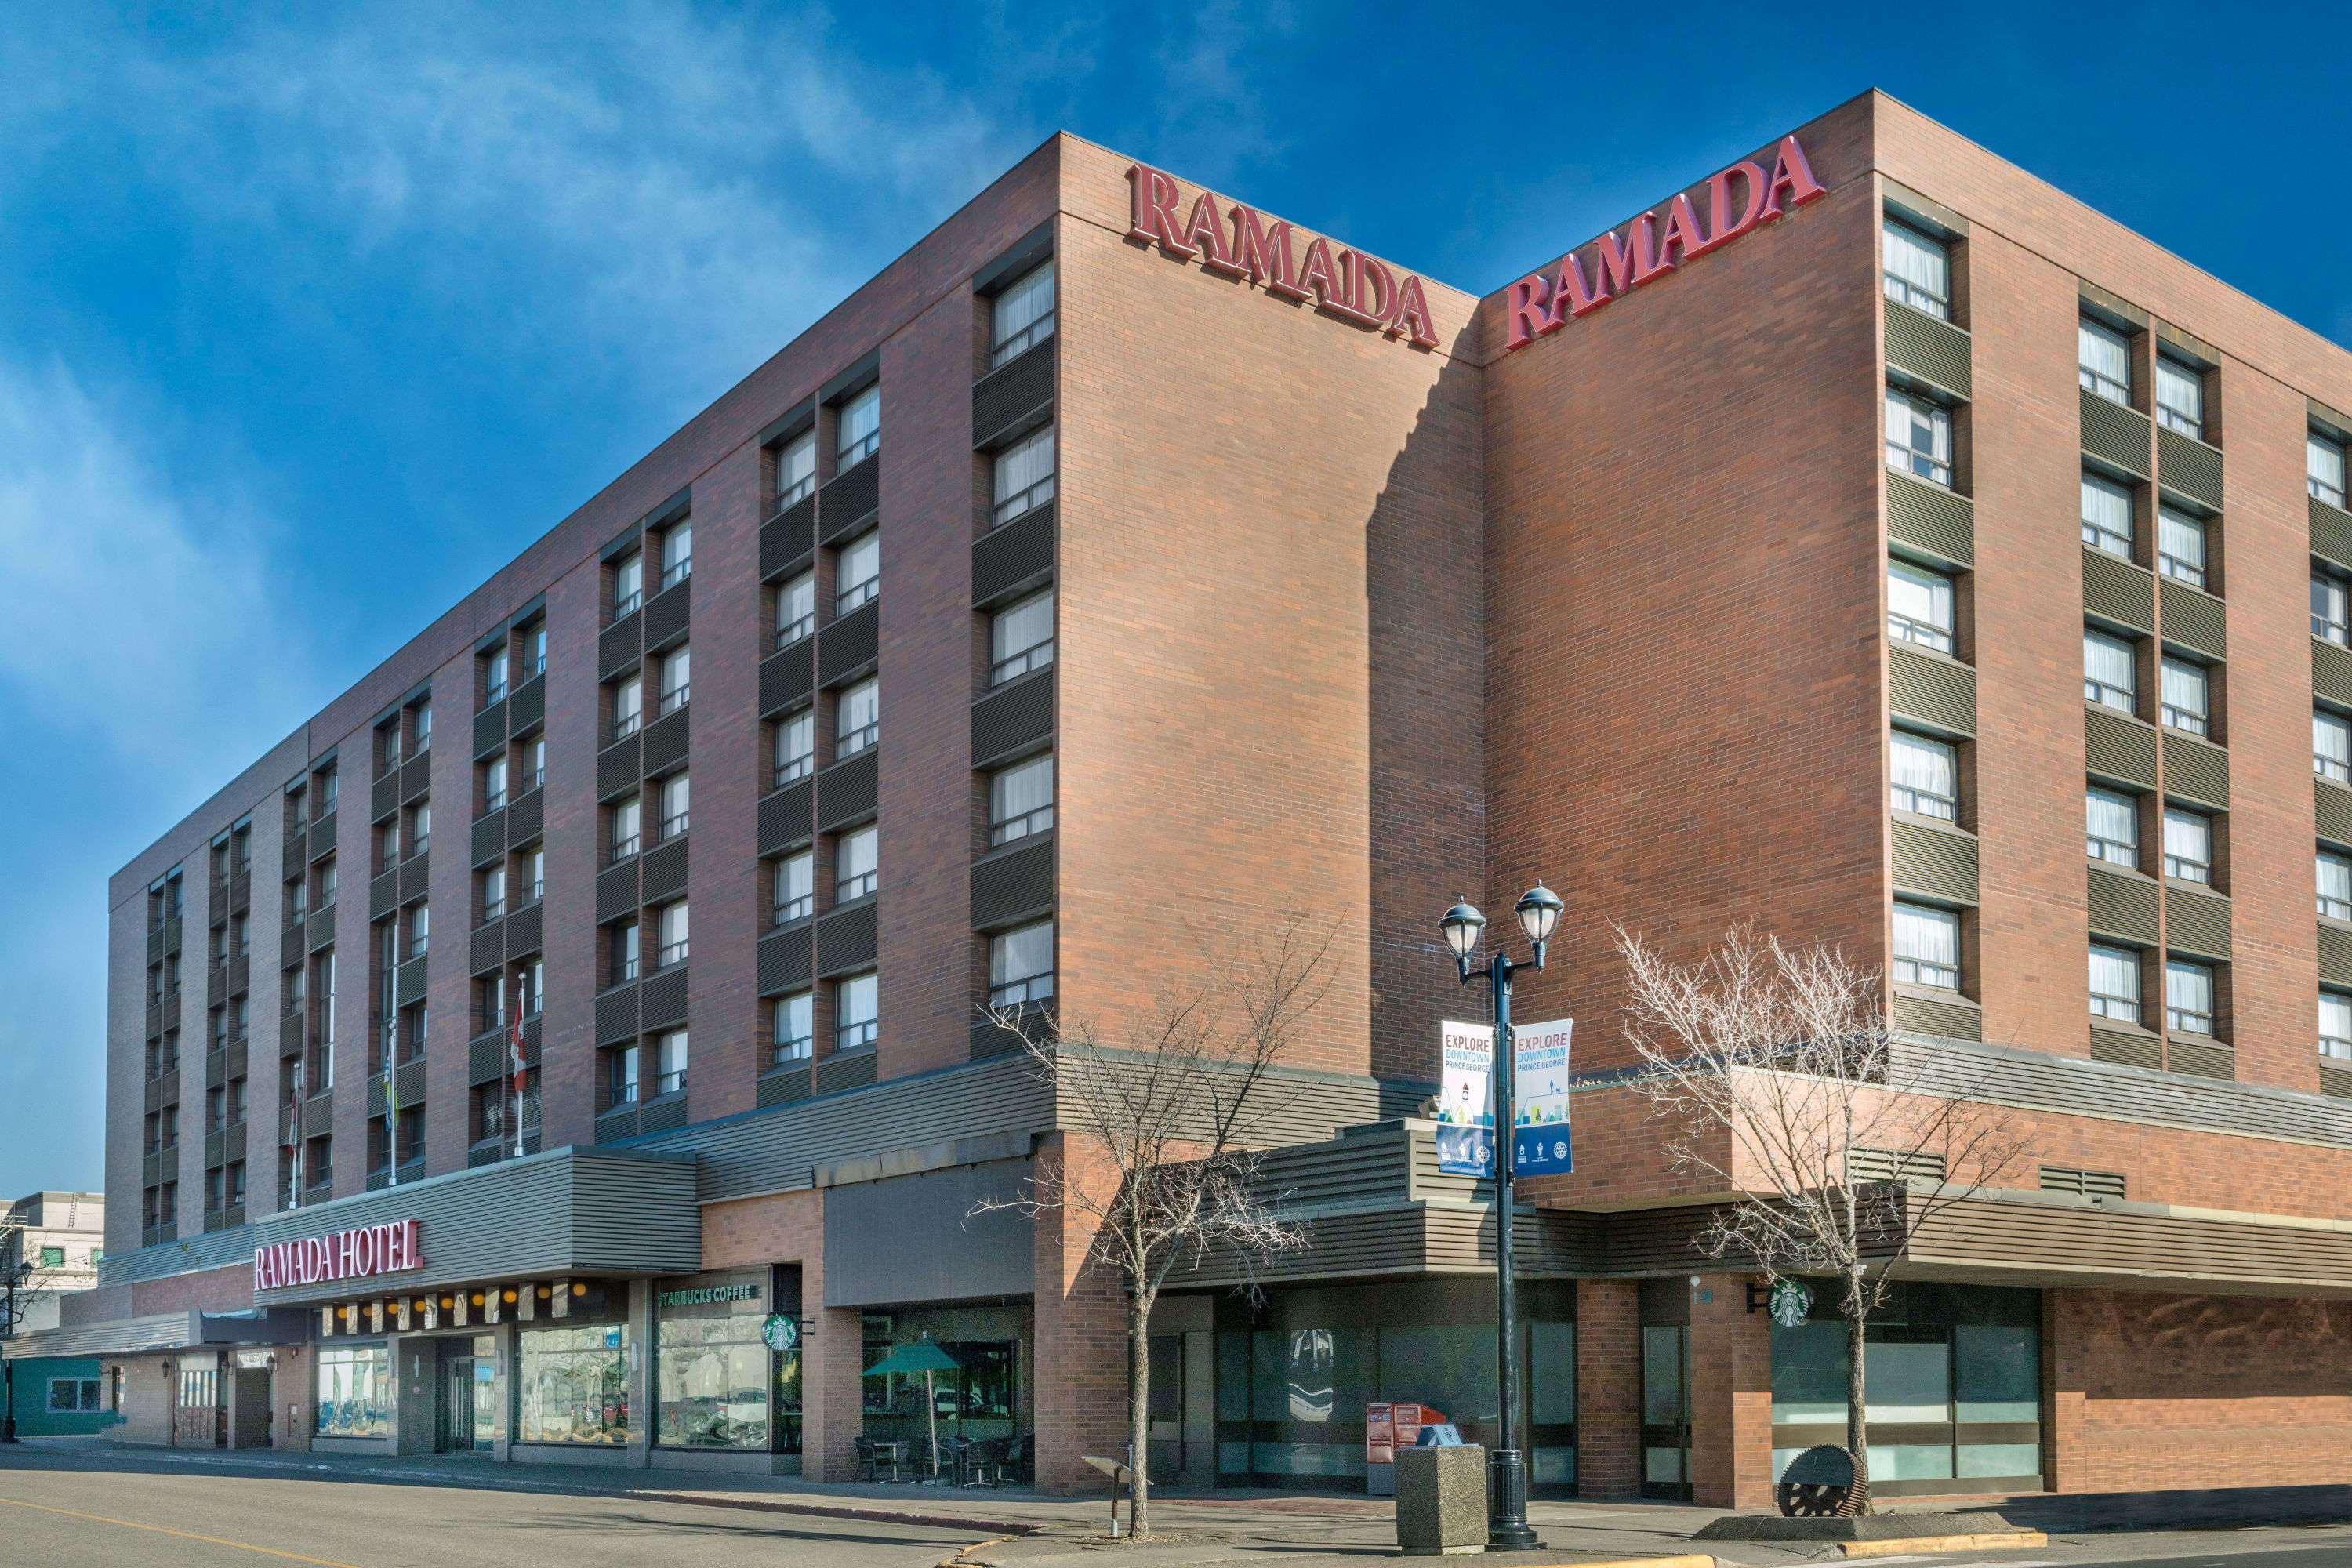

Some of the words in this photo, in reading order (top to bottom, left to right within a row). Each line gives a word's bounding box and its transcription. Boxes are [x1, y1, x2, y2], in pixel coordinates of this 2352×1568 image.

[1504, 135, 1827, 350] RAMADA
[1123, 163, 1443, 348] RAMADA
[1446, 1034, 1490, 1052] EXPLORE
[1518, 1033, 1568, 1051] EXPLORE
[1446, 1048, 1490, 1063] DOWNTOWN
[1518, 1047, 1566, 1063] DOWNTOWN
[1446, 1061, 1466, 1069] PRINCE
[1466, 1062, 1490, 1073] GEORGE
[1518, 1061, 1540, 1072] PRINCE
[1542, 1058, 1566, 1069] GEORGE
[254, 1235, 337, 1290] RAMADA
[338, 1218, 423, 1279] HOTEL
[657, 1288, 712, 1306] STARBUCKS
[713, 1284, 751, 1301] COFFEE
